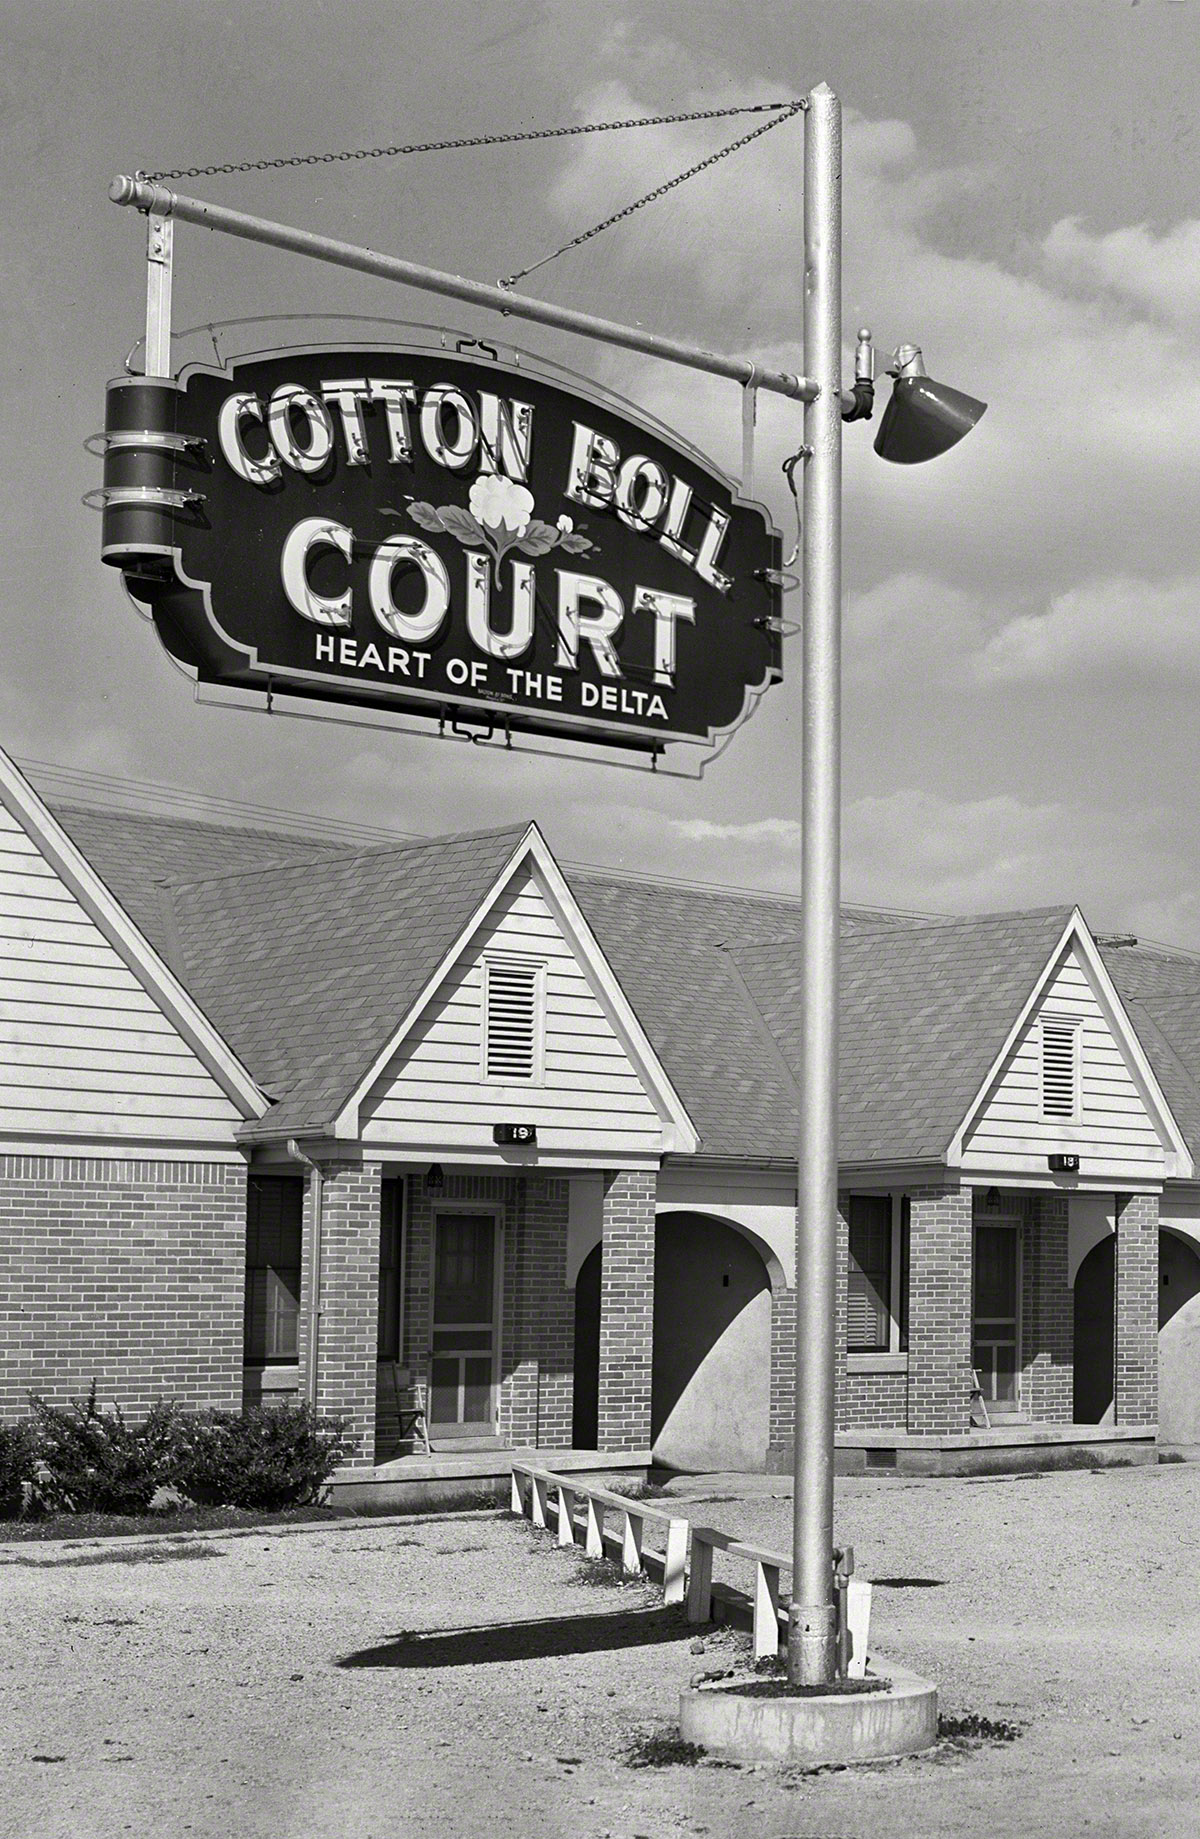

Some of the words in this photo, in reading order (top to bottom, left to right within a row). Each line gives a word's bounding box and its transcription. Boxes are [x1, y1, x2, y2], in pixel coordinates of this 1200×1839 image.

[218, 378, 535, 484] COTTON
[563, 420, 735, 593] BOLL
[281, 516, 697, 689] COURT
[315, 634, 431, 678] HEART
[446, 658, 488, 687] OF
[506, 668, 563, 701] THE
[581, 682, 669, 720] DELTA
[512, 1127, 529, 1139] 19
